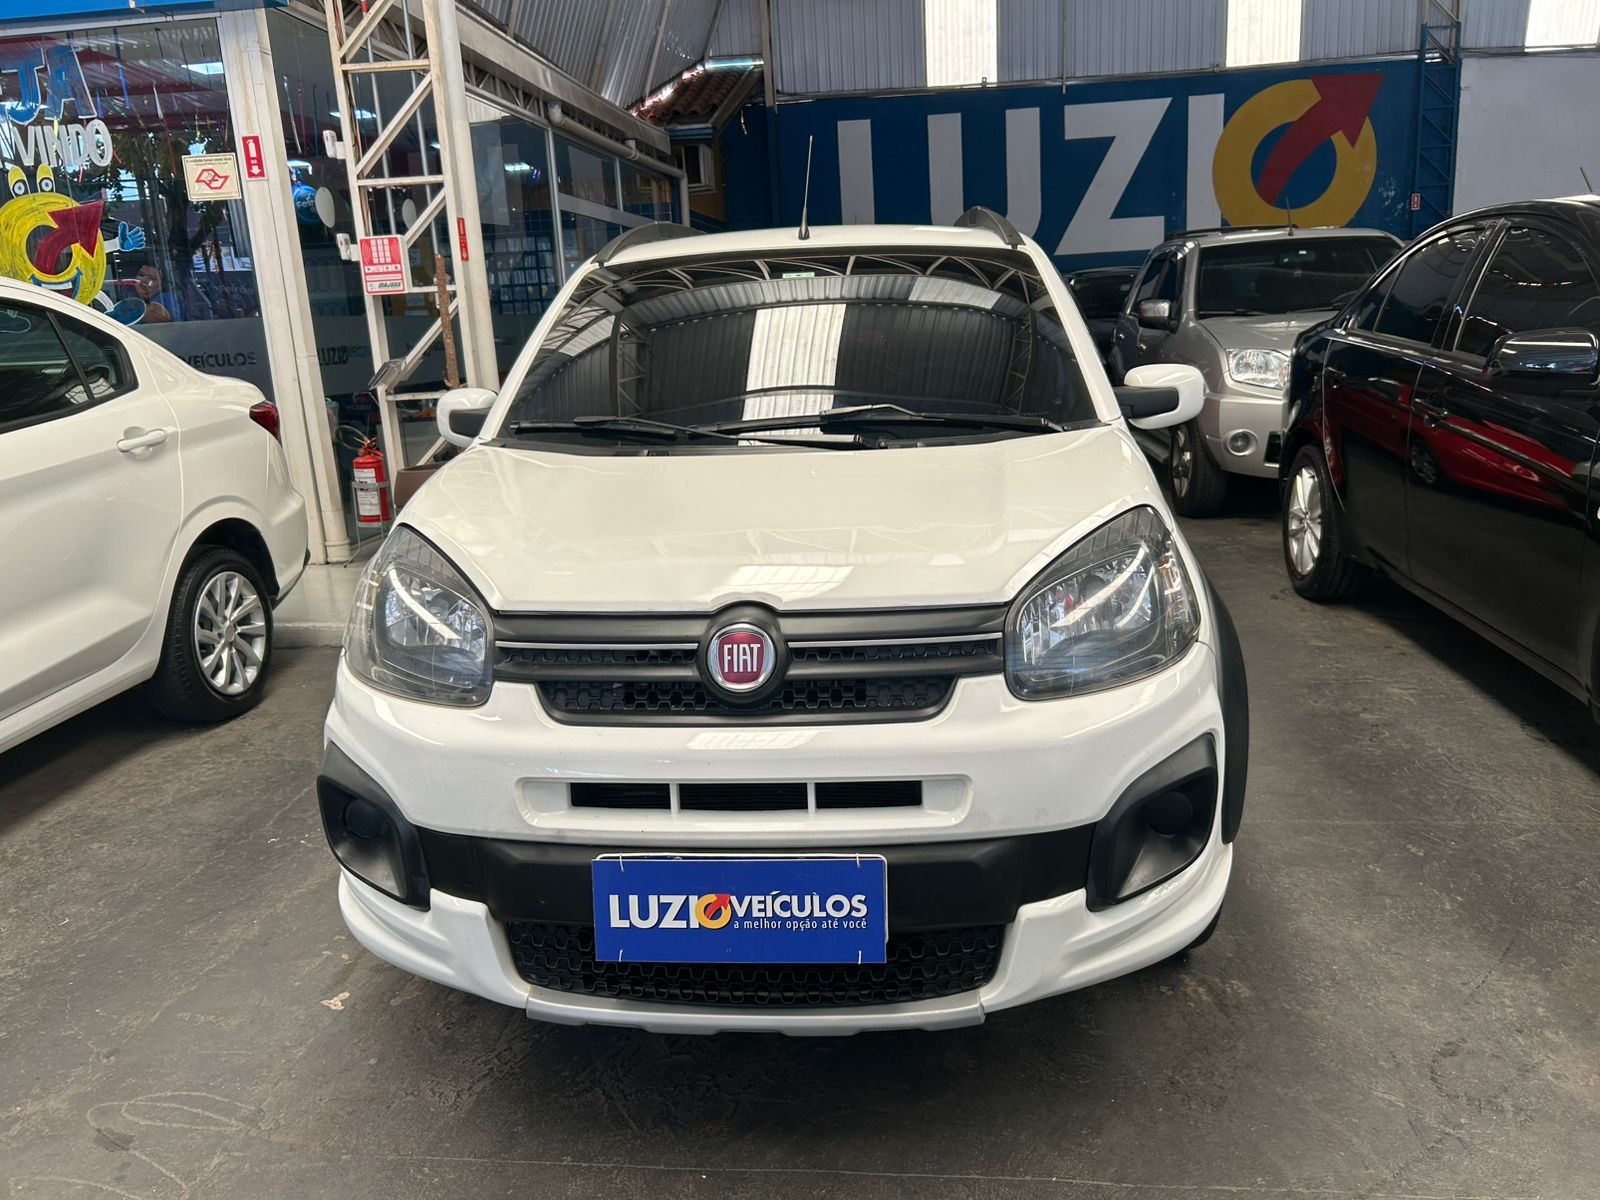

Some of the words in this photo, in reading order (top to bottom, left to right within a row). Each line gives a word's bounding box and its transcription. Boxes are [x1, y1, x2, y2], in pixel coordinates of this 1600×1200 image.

[0, 45, 97, 125] JA
[11, 119, 113, 168] VINDO
[723, 643, 761, 672] FIAT
[609, 894, 731, 929] LUZIO
[730, 890, 868, 918] VEÍCULOS
[733, 920, 740, 929] a
[744, 919, 782, 929] melhor
[786, 918, 818, 931] opção
[821, 918, 839, 929] até
[843, 917, 868, 929] você
